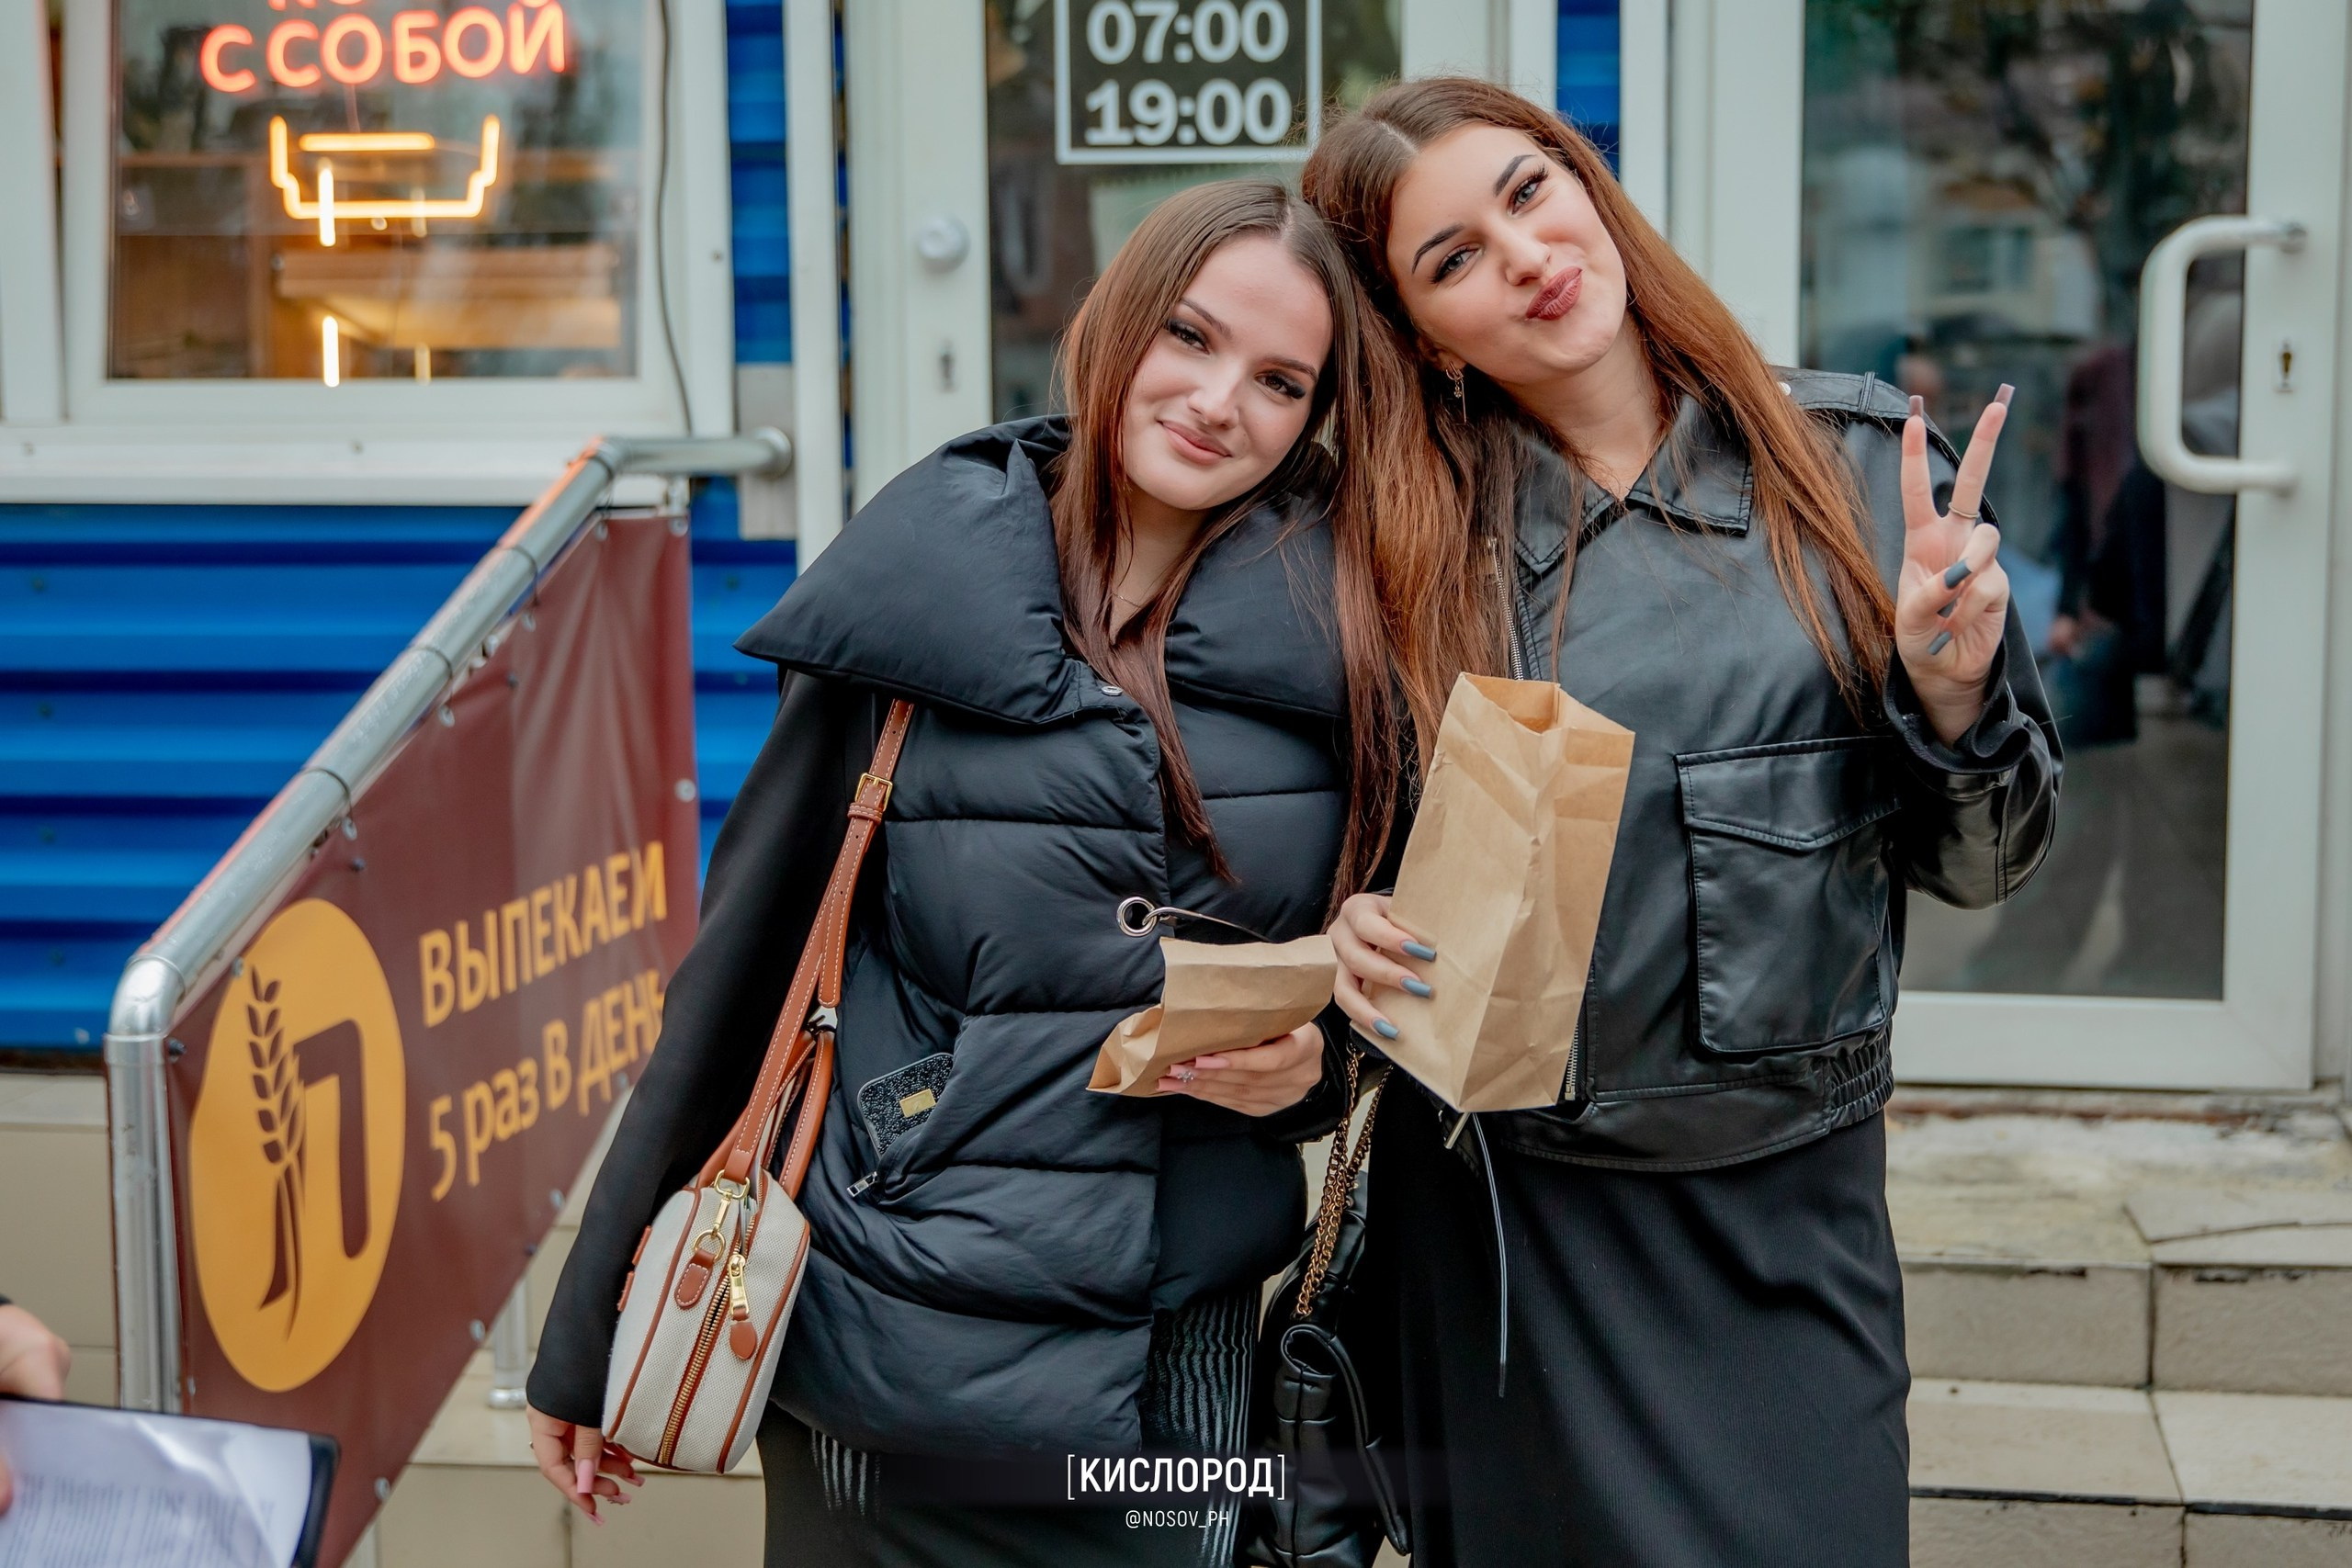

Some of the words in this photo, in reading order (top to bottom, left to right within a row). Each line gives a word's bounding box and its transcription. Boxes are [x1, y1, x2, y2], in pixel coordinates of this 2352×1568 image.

[200, 23, 256, 93] С
[266, 0, 567, 87] СОБОЙ
[1086, 0, 1289, 64] 07:00
[1084, 77, 1293, 145] 19:00
[419, 840, 667, 1028] ВЫПЕКАЕМ
[429, 1095, 458, 1202] 5
[463, 1057, 540, 1187] раз
